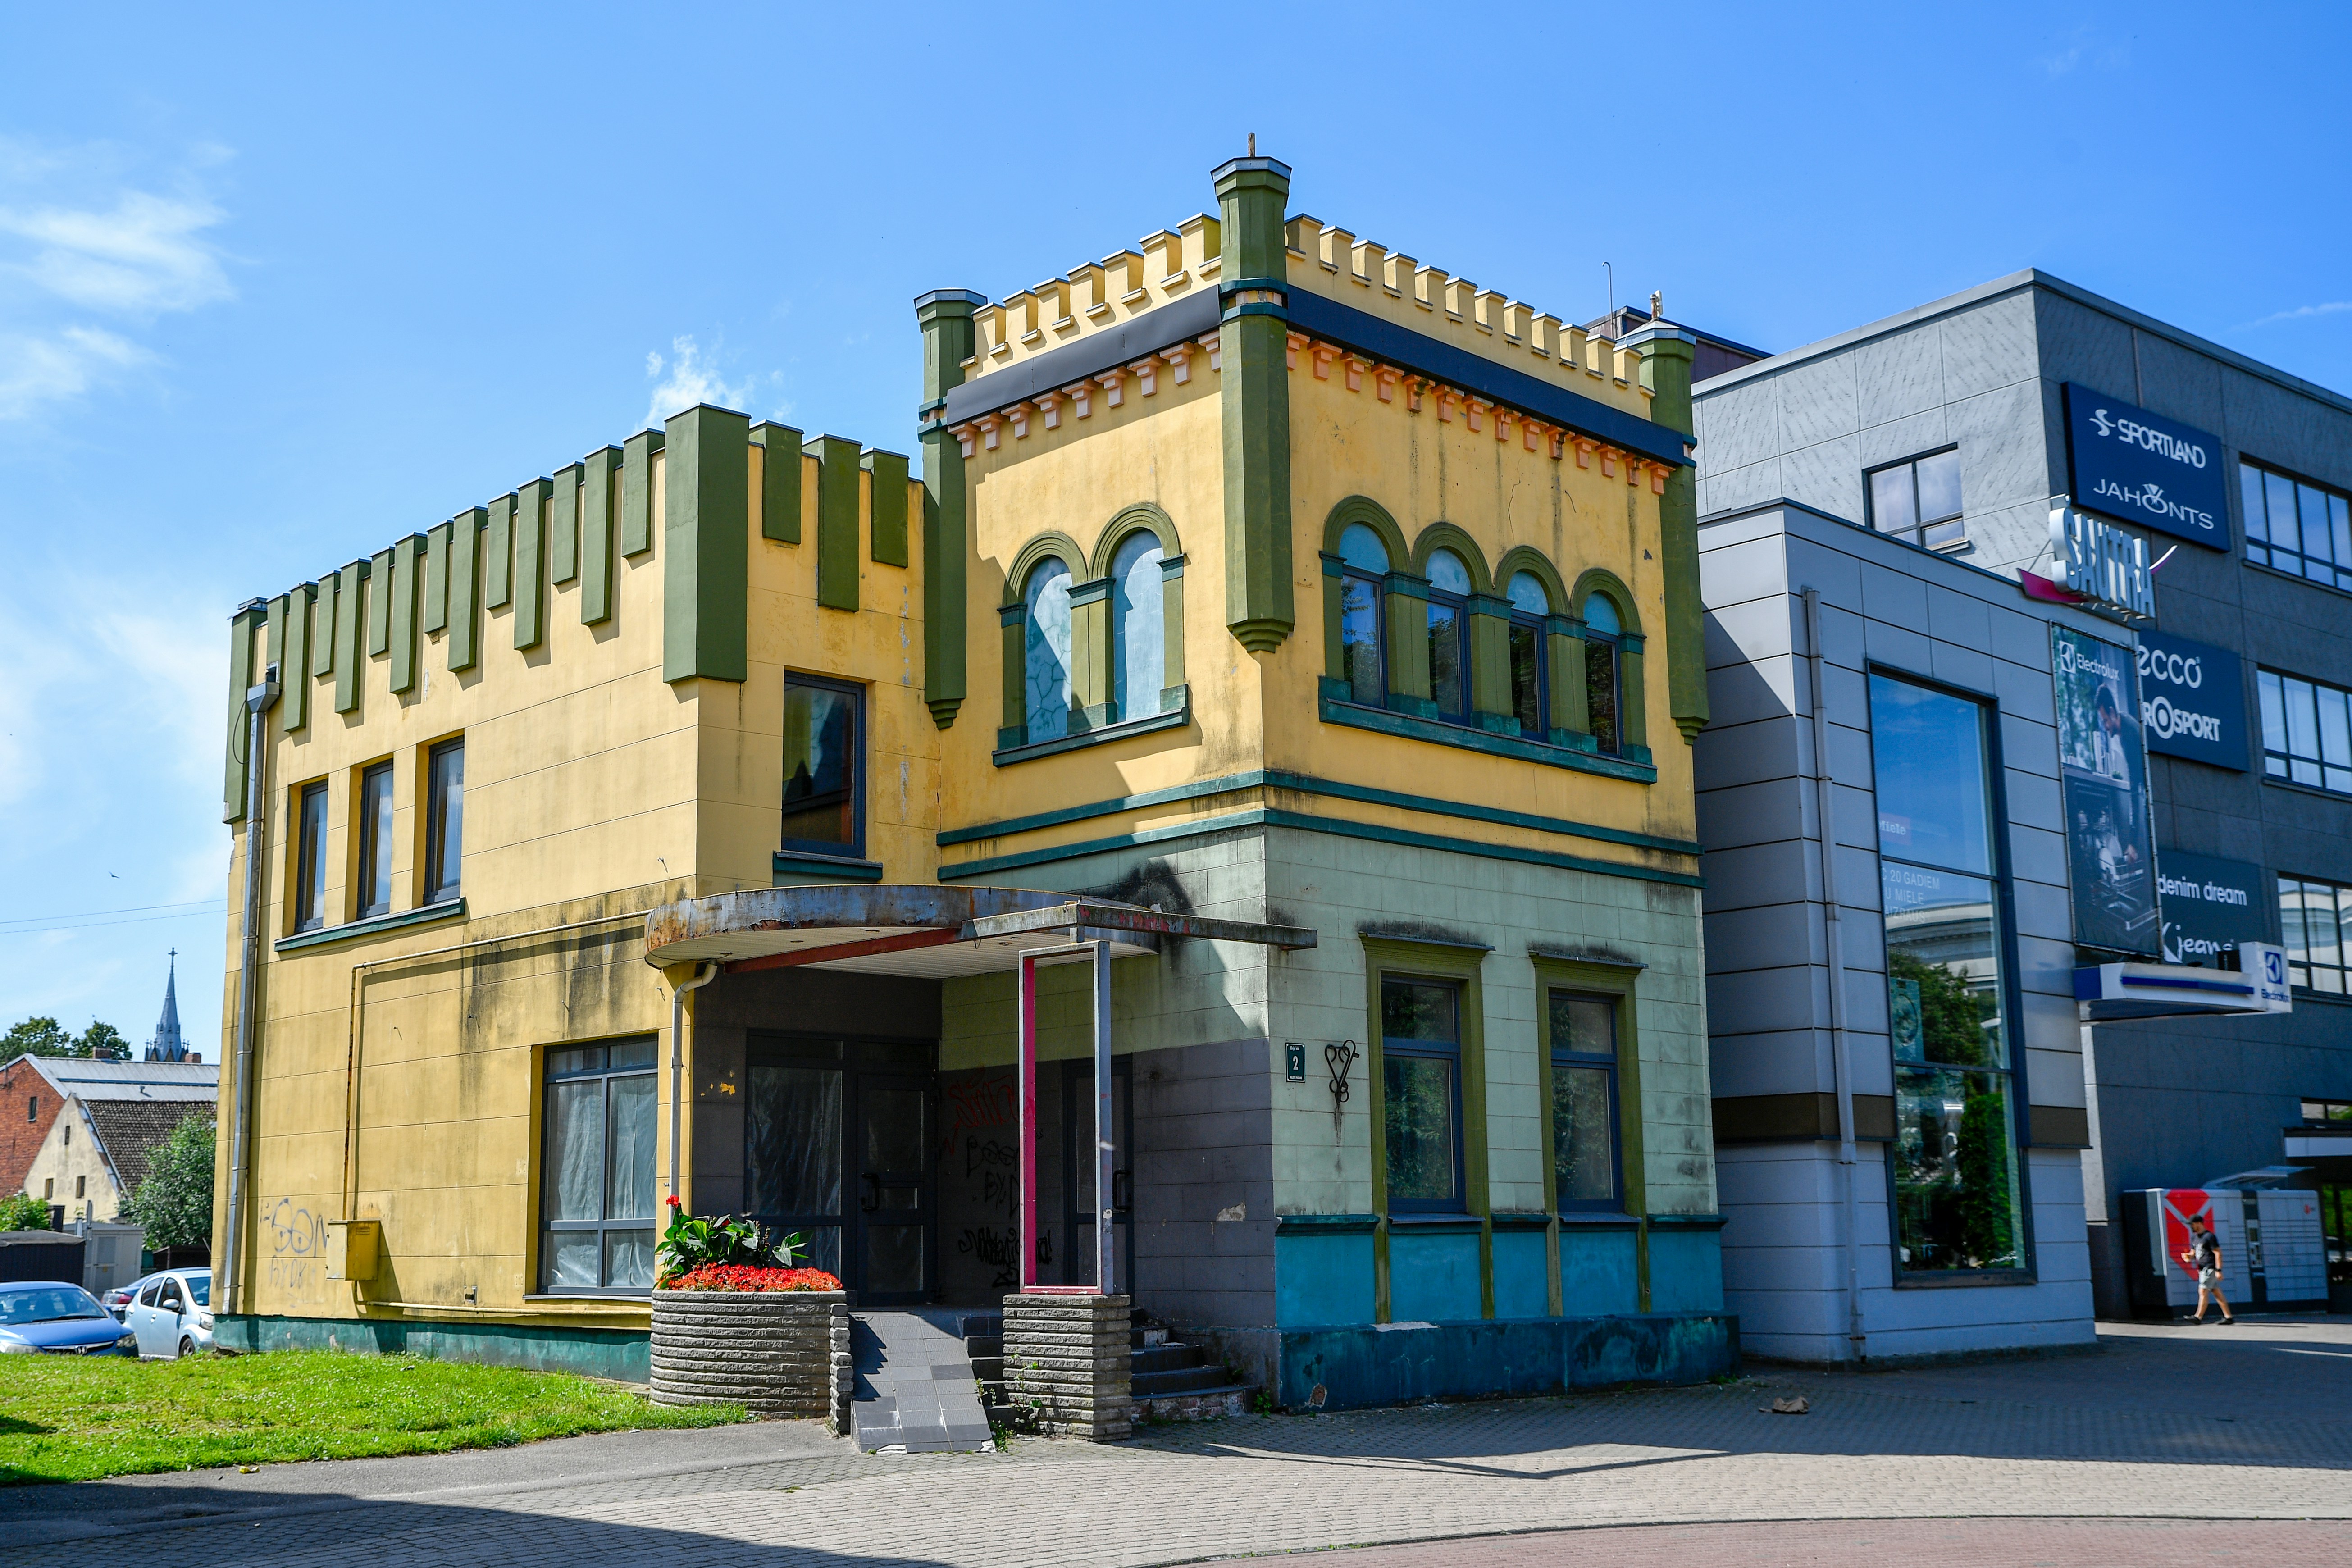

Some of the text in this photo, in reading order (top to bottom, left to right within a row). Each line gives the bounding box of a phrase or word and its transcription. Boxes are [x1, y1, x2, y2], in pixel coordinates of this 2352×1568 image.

[2117, 419, 2206, 468] SPORTLAND
[2093, 479, 2214, 530] JAHONTS
[2076, 653, 2120, 681] Electrolux
[1890, 870, 1901, 883] 20
[1903, 872, 1940, 889] GADIEM
[2158, 874, 2247, 906] denim dream
[1895, 888, 1924, 905] MIELE
[1293, 1056, 1299, 1070] 2
